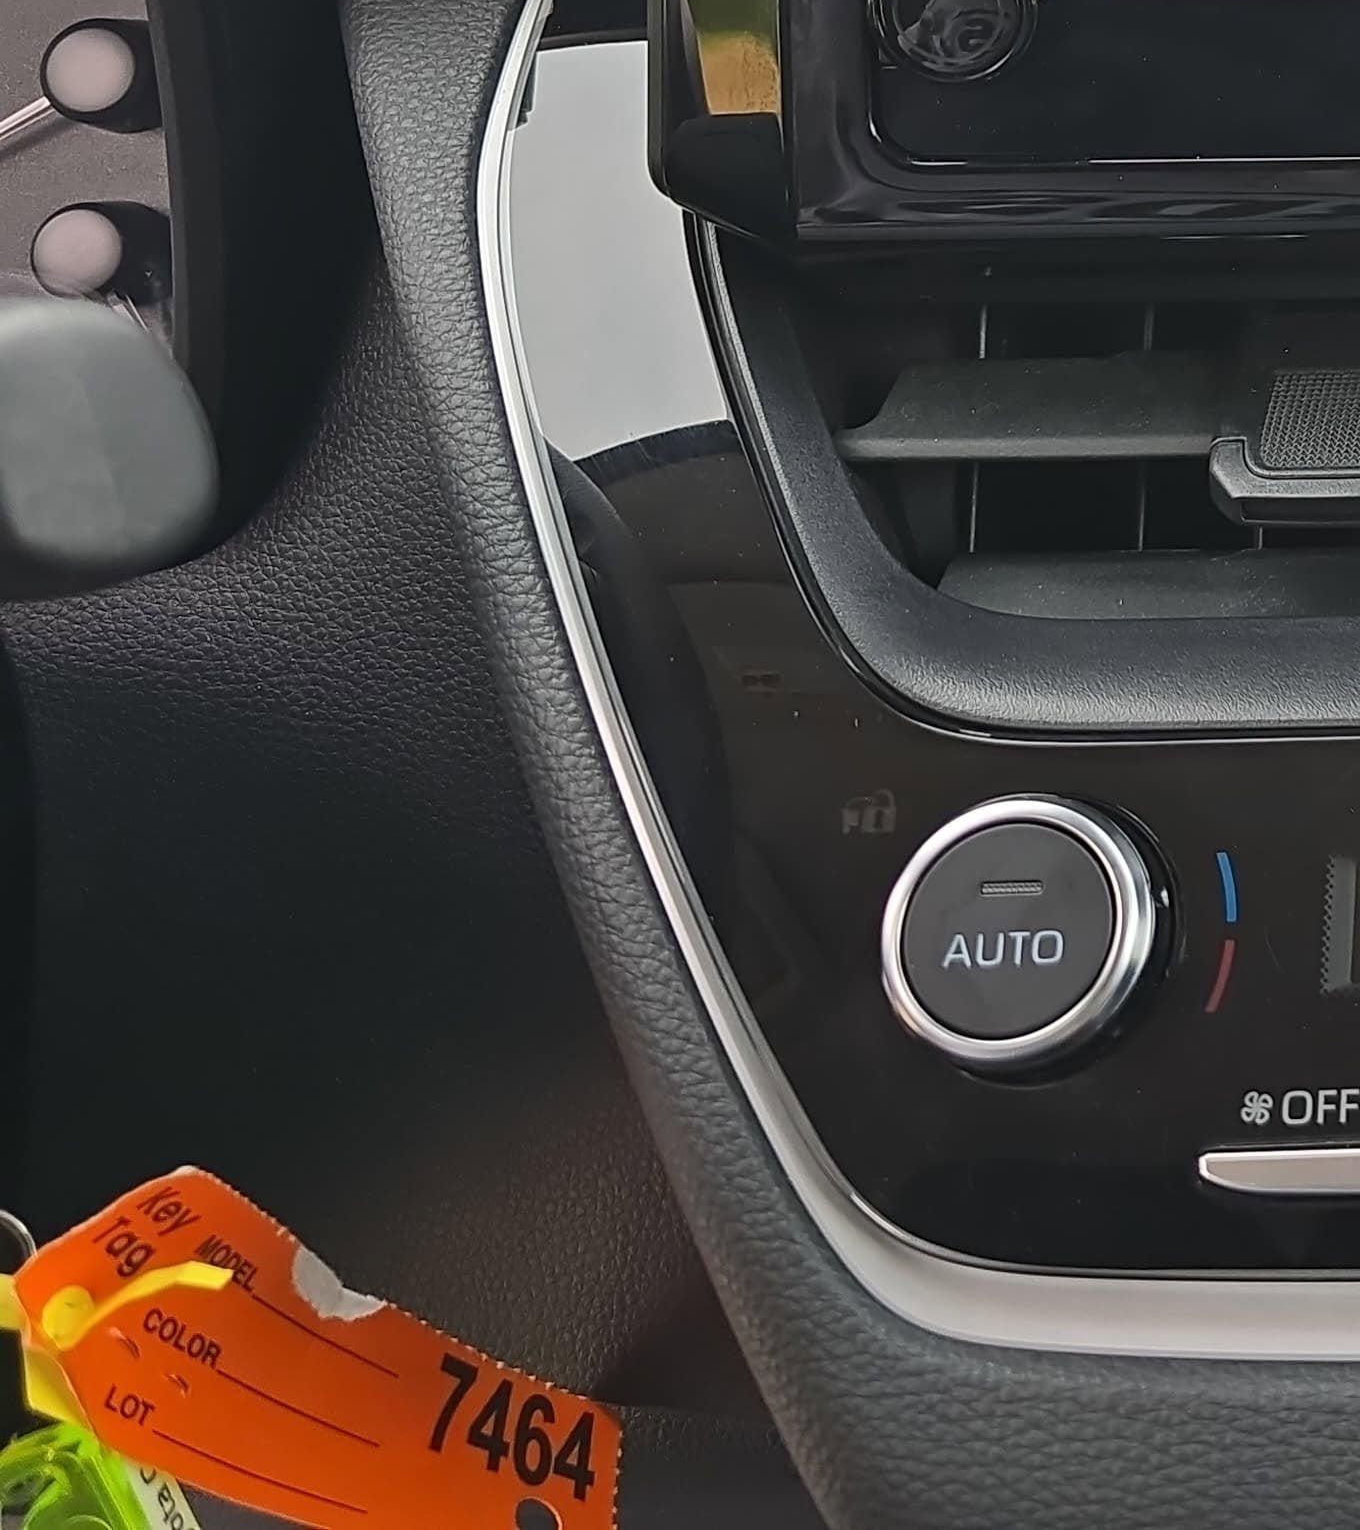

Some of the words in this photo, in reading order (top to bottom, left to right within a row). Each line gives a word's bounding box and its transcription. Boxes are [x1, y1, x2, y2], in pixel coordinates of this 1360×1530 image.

[942, 930, 1064, 969] AUTO
[1281, 1088, 1360, 1125] OFF
[136, 1187, 202, 1237] Key
[92, 1216, 157, 1278] Tag
[143, 1308, 221, 1369] COLOR
[104, 1384, 155, 1426] LOT
[428, 1352, 596, 1502] 7464
